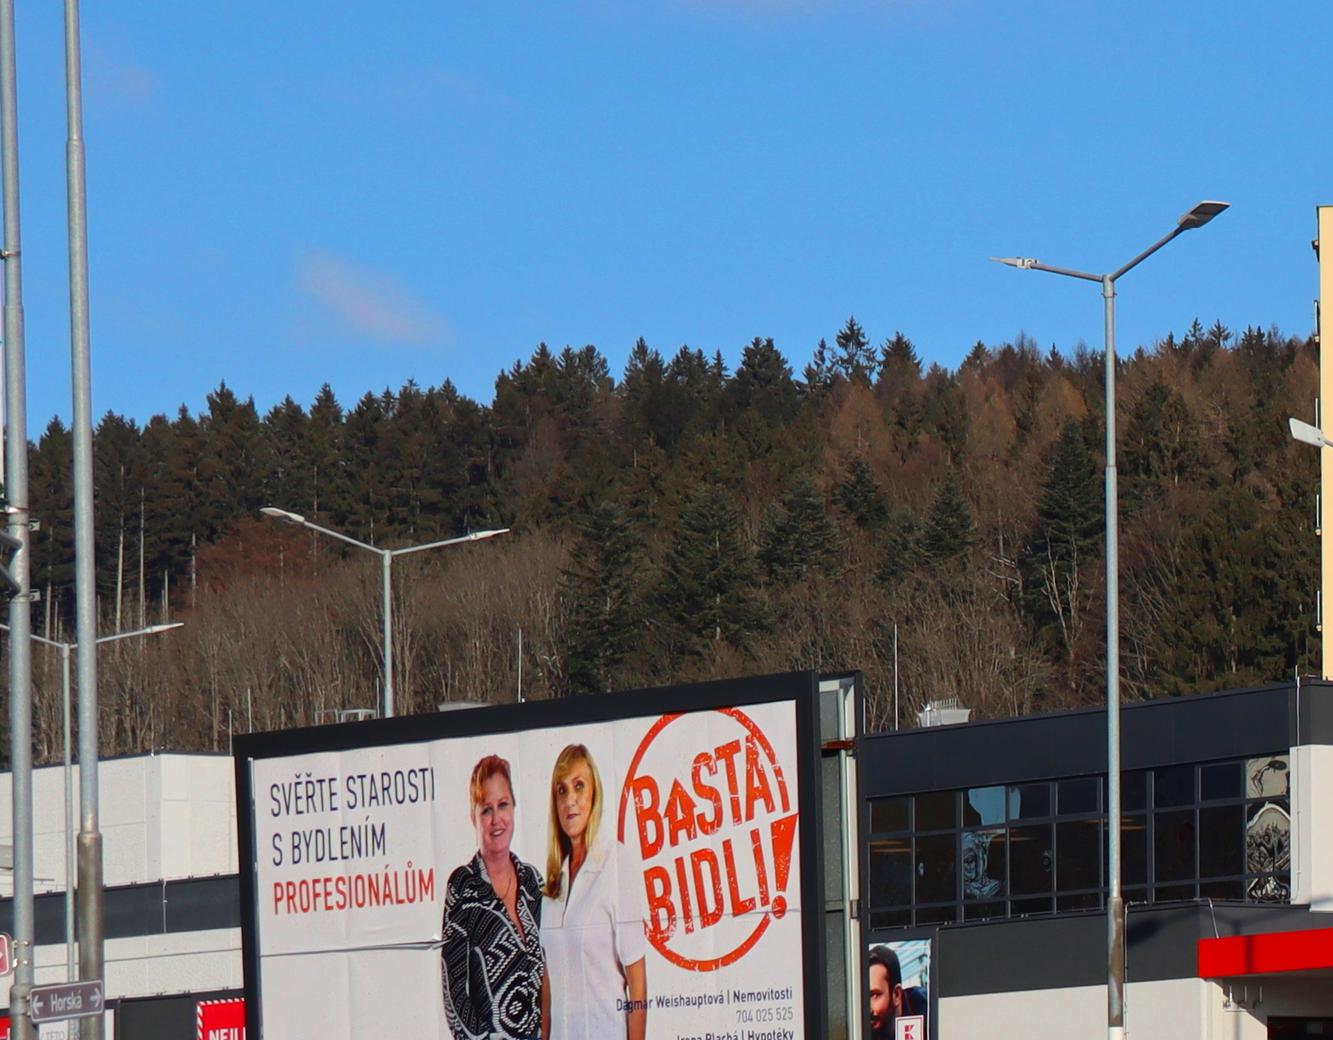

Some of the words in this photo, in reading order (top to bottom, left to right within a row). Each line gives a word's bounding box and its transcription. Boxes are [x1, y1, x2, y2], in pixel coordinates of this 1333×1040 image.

[270, 772, 338, 817] SVĚŘTE
[345, 768, 435, 810] STAROSTI
[272, 832, 283, 867] S
[292, 816, 386, 865] BYDLENÍM
[273, 860, 435, 915] PROFESIONÁLŮM
[643, 812, 799, 940] BIDLI!
[50, 990, 82, 1013] Horská
[616, 997, 653, 1014] Dagmar
[655, 990, 724, 1011] Weishauptová
[733, 986, 793, 1003] Nemovitosti
[736, 1009, 753, 1024] 704
[756, 1008, 773, 1022] 025
[776, 1007, 793, 1021] 525
